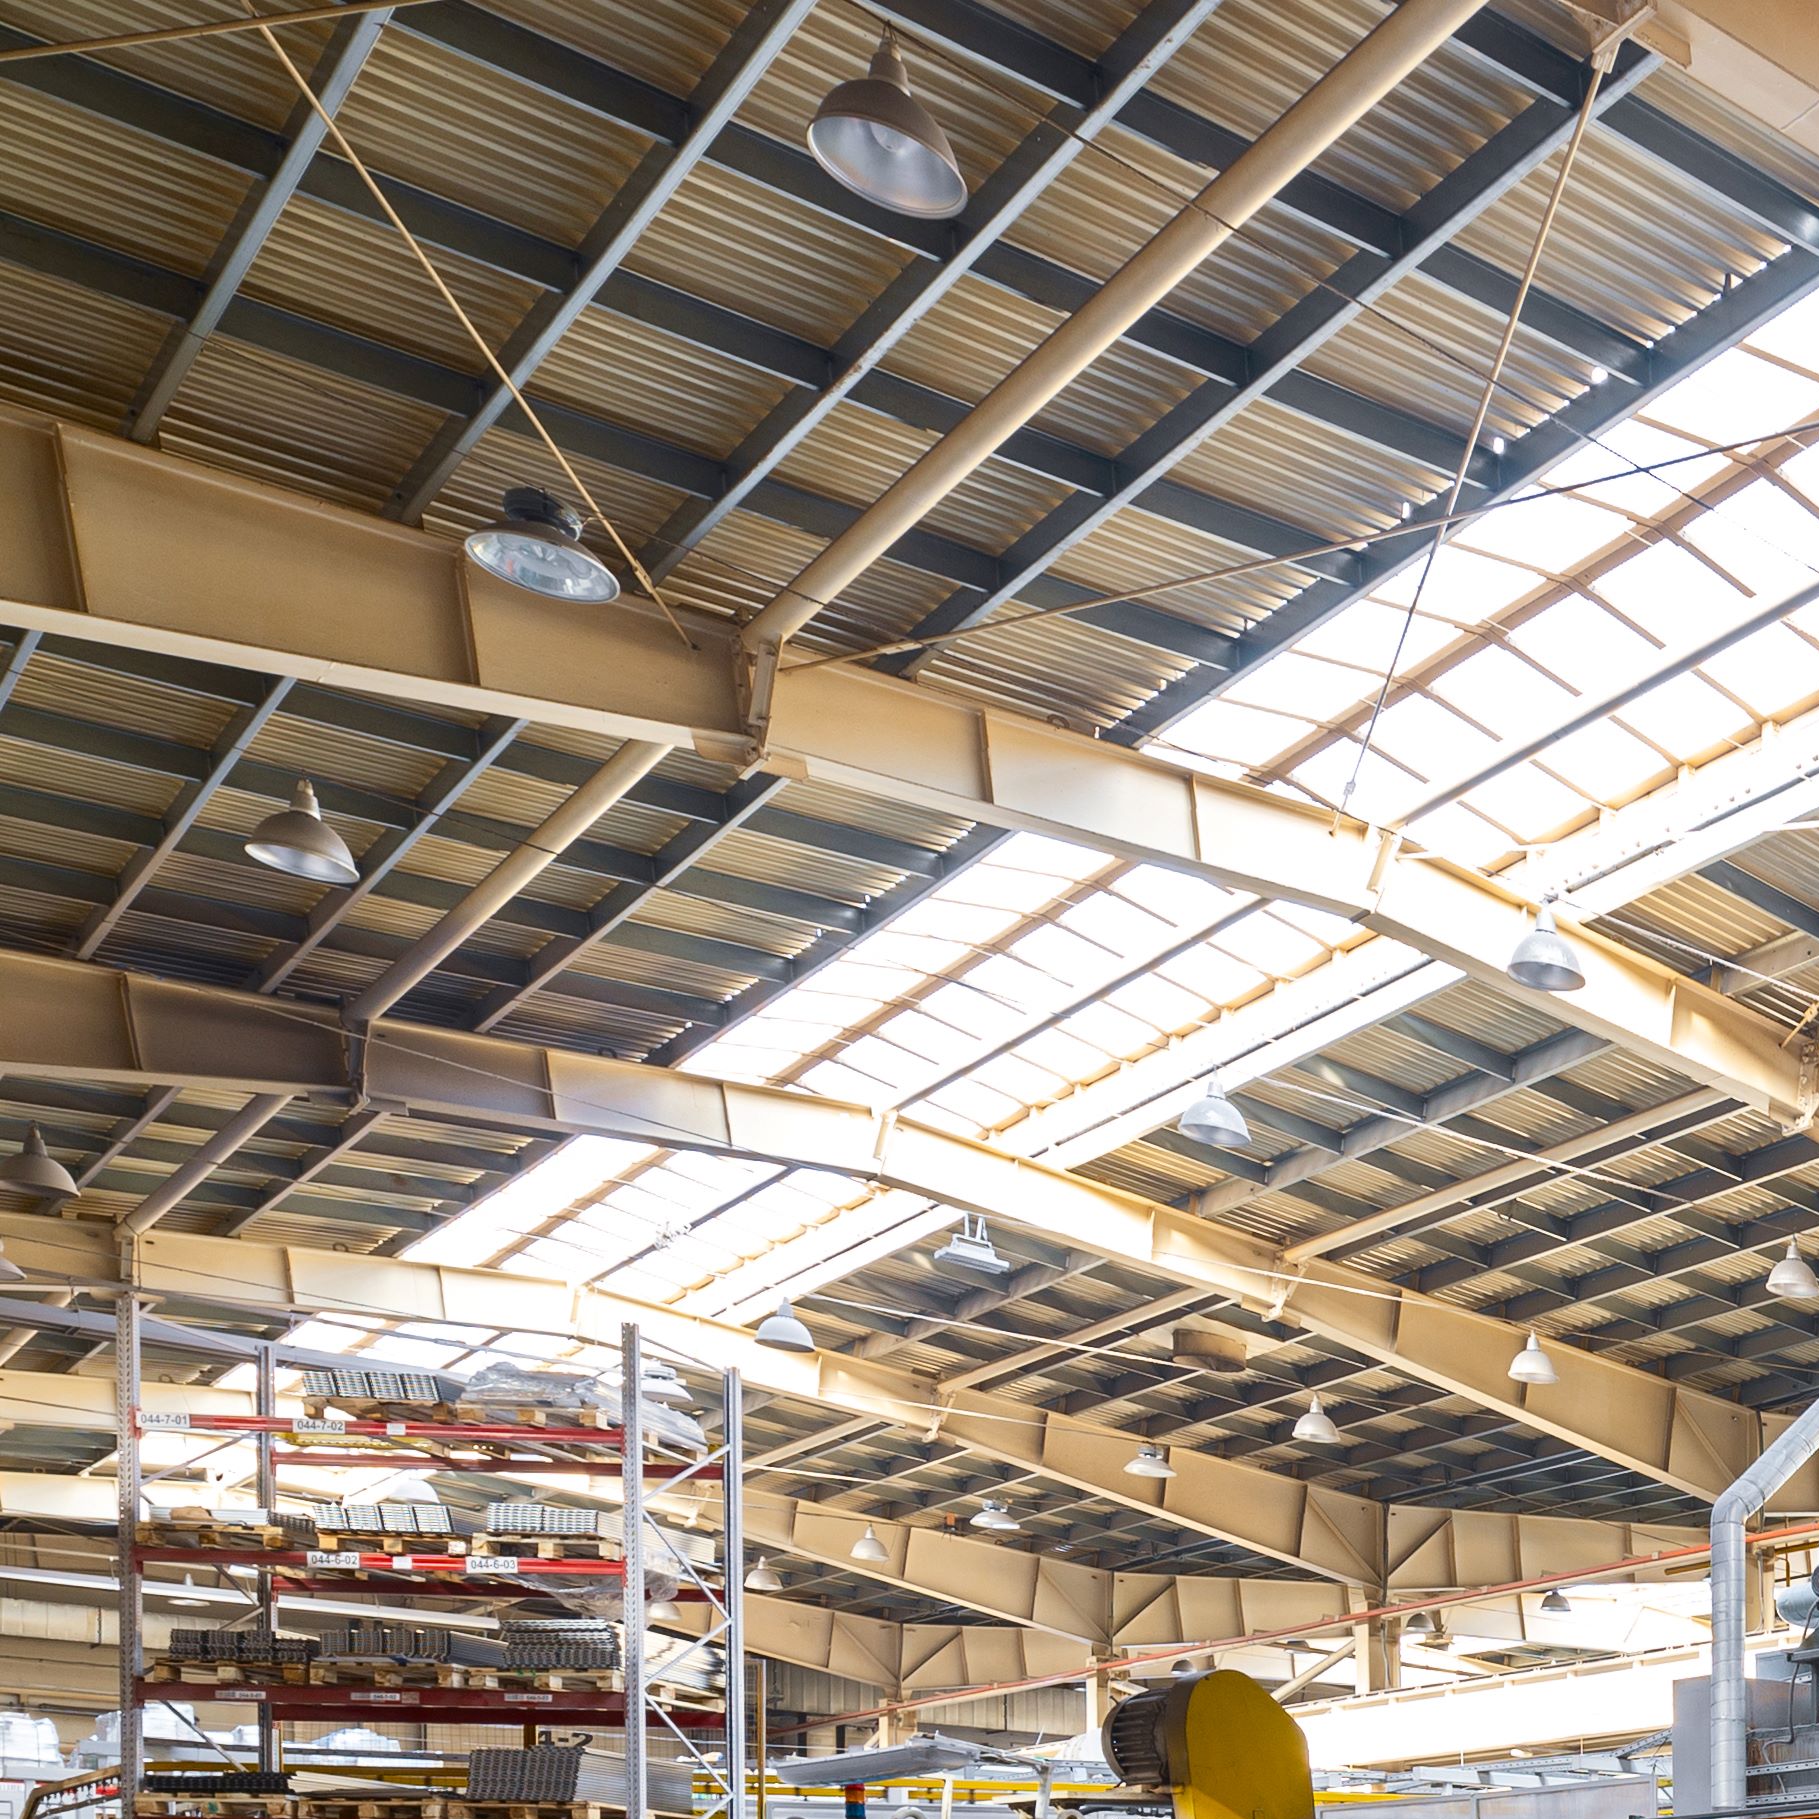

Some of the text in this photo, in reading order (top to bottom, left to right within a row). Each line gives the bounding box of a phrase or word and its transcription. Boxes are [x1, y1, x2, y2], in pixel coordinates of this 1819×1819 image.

[140, 1414, 187, 1425] 044-7-01
[297, 1420, 344, 1431] 044-7-02
[311, 1554, 358, 1566] 044-6-02
[471, 1559, 516, 1570] 044-6-03
